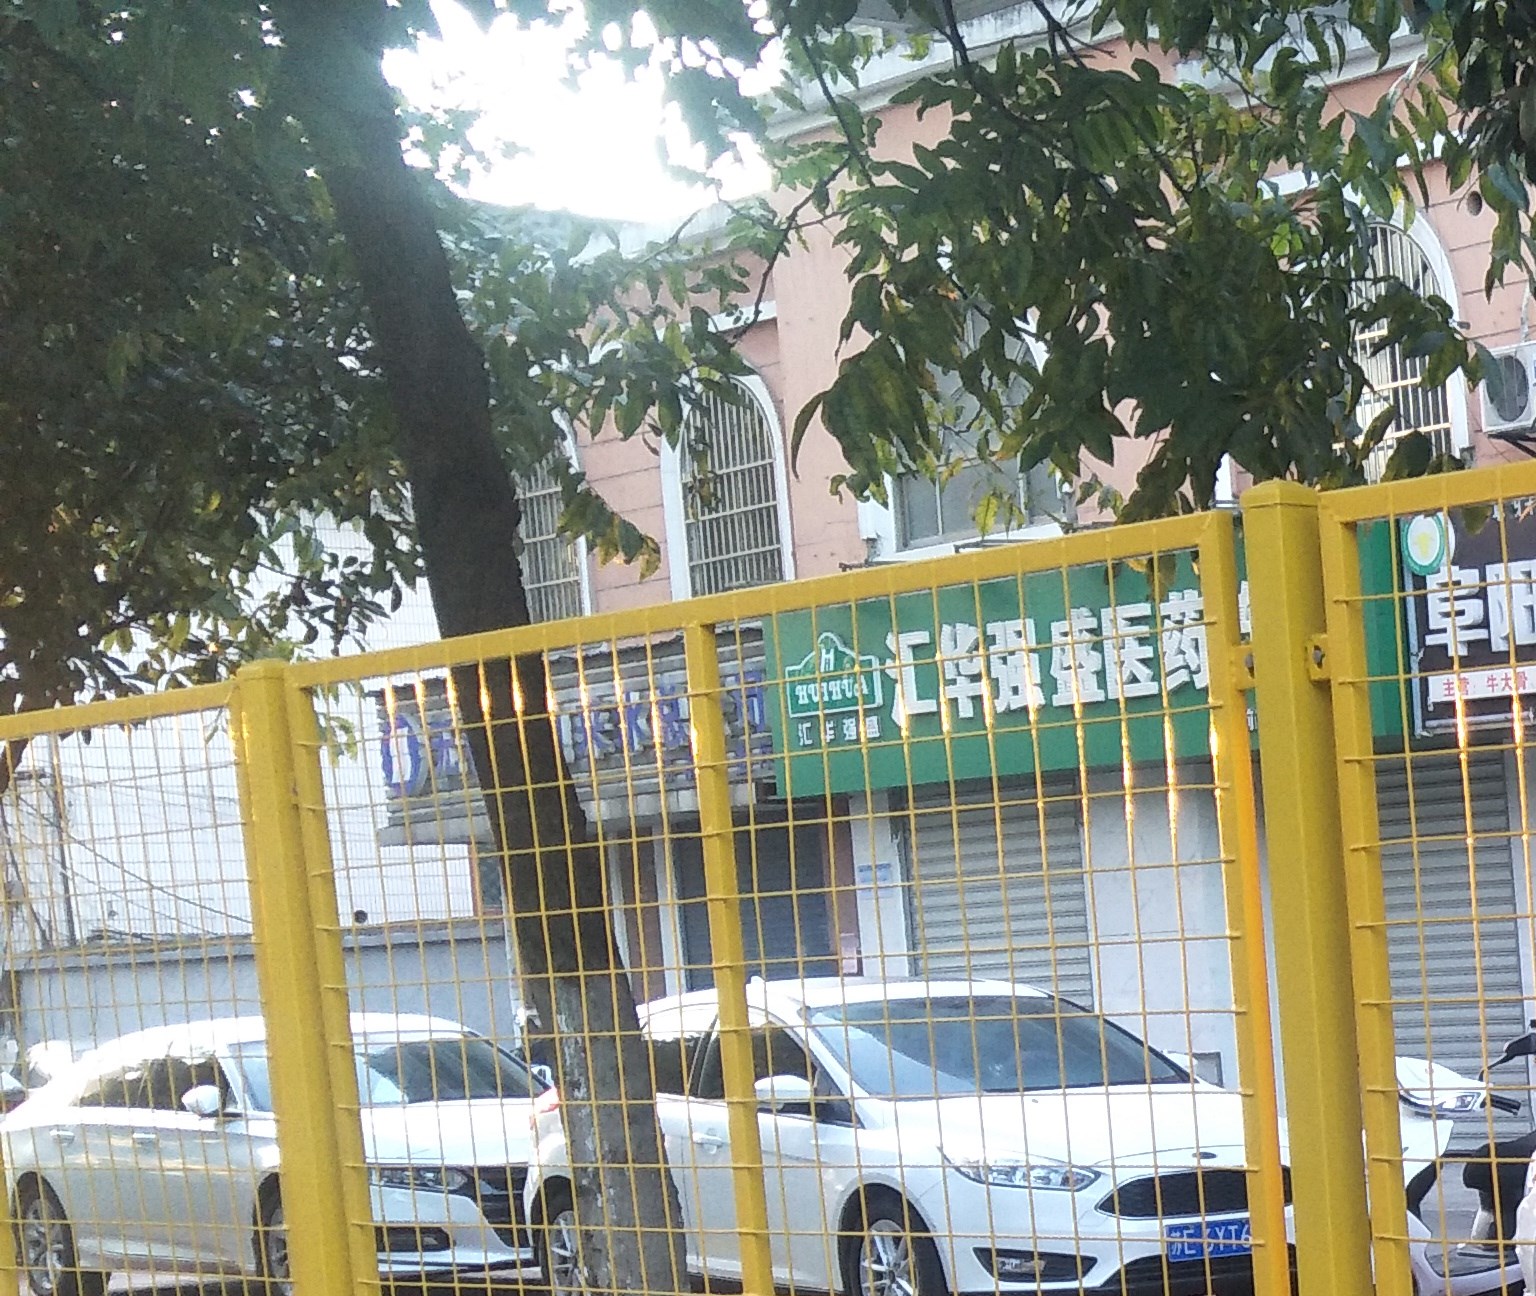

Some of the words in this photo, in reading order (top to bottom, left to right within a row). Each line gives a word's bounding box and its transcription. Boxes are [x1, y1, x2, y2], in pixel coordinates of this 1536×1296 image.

[885, 580, 1250, 726] 汇华强盛医药
